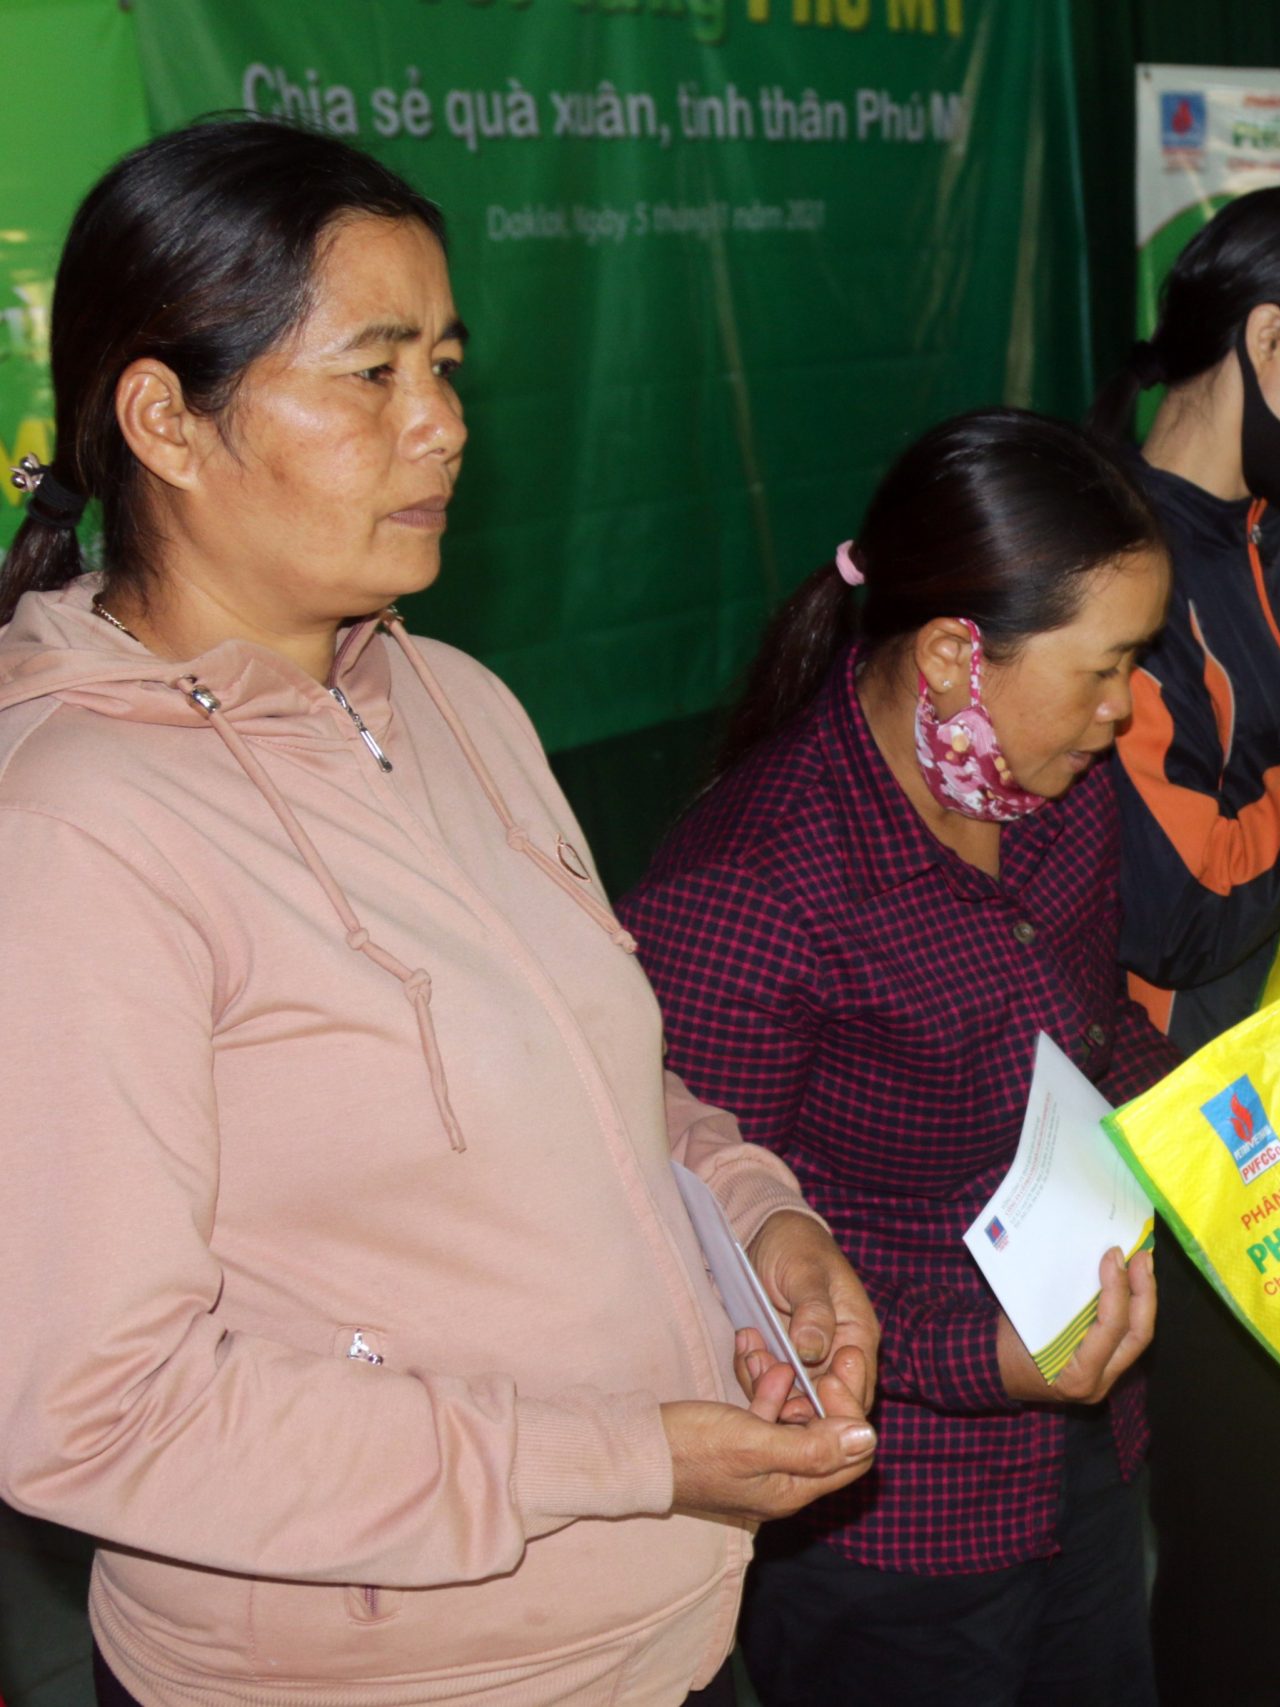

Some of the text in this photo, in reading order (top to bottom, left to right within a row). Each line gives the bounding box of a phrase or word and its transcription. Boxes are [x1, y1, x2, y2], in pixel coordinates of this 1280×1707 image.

[243, 62, 358, 136] Chia
[371, 66, 433, 138] sẻ
[445, 77, 540, 151] quà
[552, 80, 671, 149] xuân,
